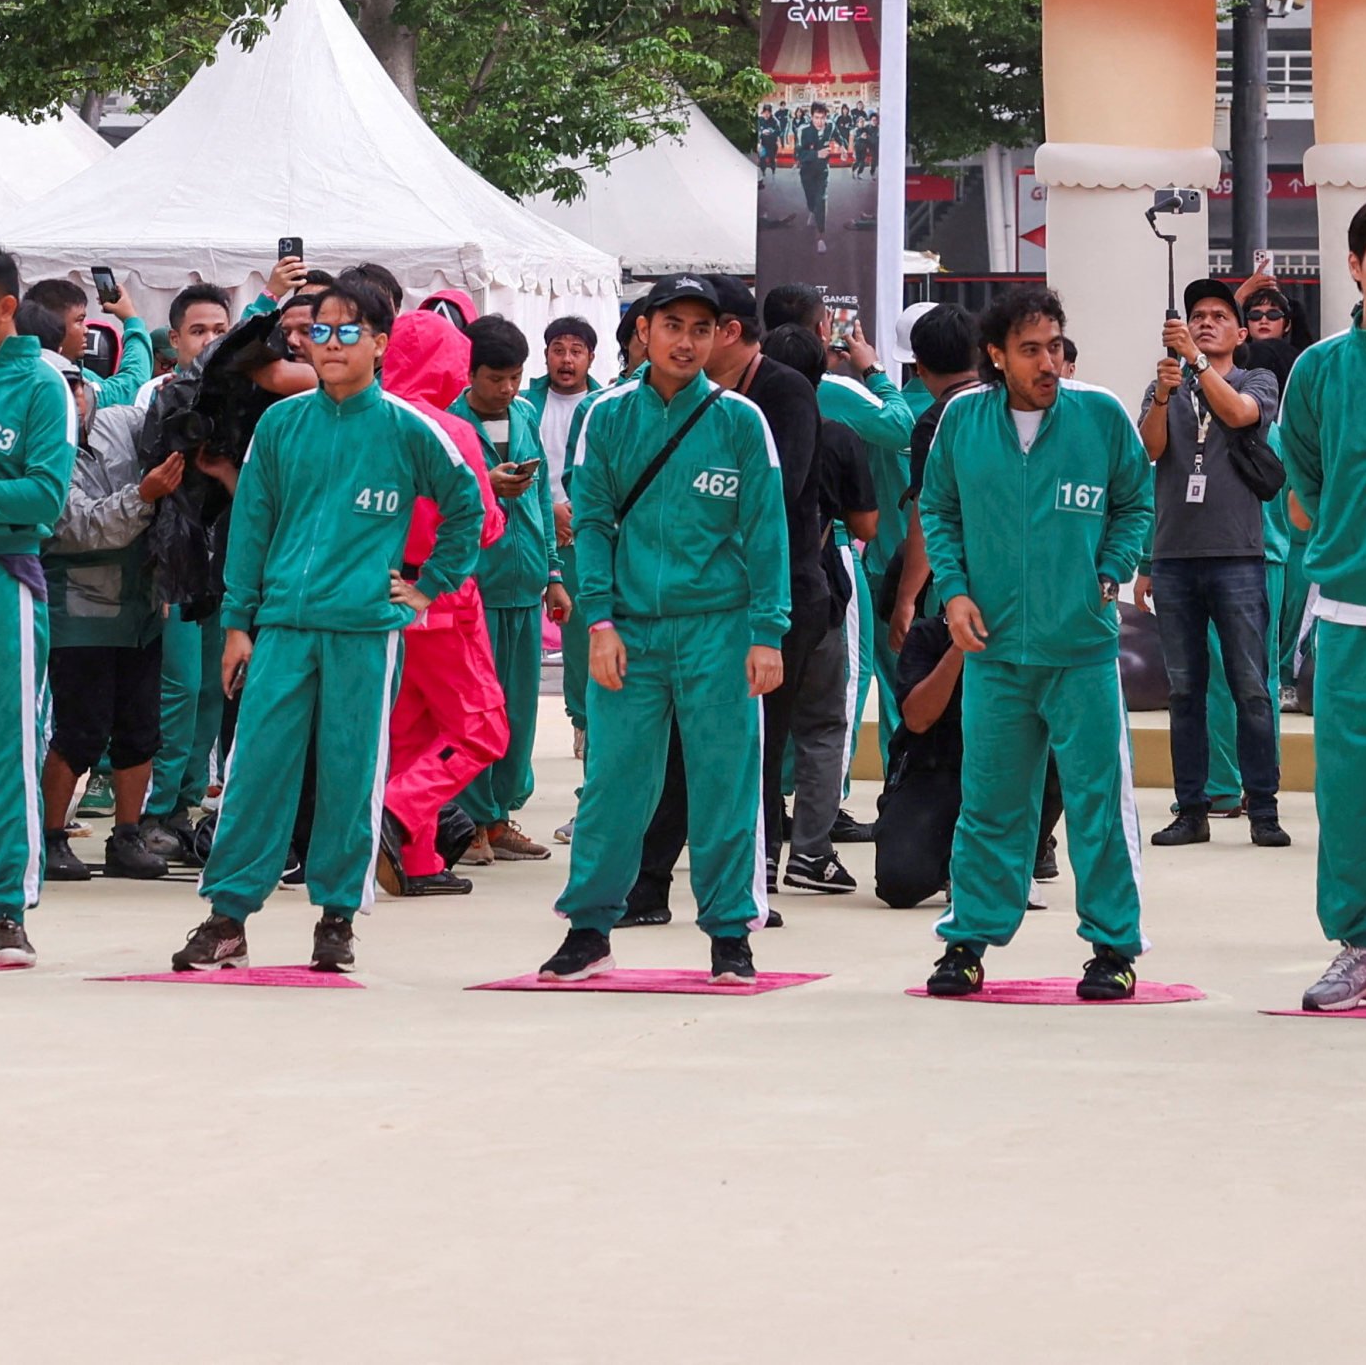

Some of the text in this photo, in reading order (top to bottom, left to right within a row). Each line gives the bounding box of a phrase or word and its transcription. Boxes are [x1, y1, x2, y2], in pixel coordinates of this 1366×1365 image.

[787, 6, 873, 29] GAME 2
[822, 295, 858, 304] GAMES
[692, 470, 739, 498] 462
[1060, 482, 1104, 509] 167
[355, 487, 399, 513] 410
